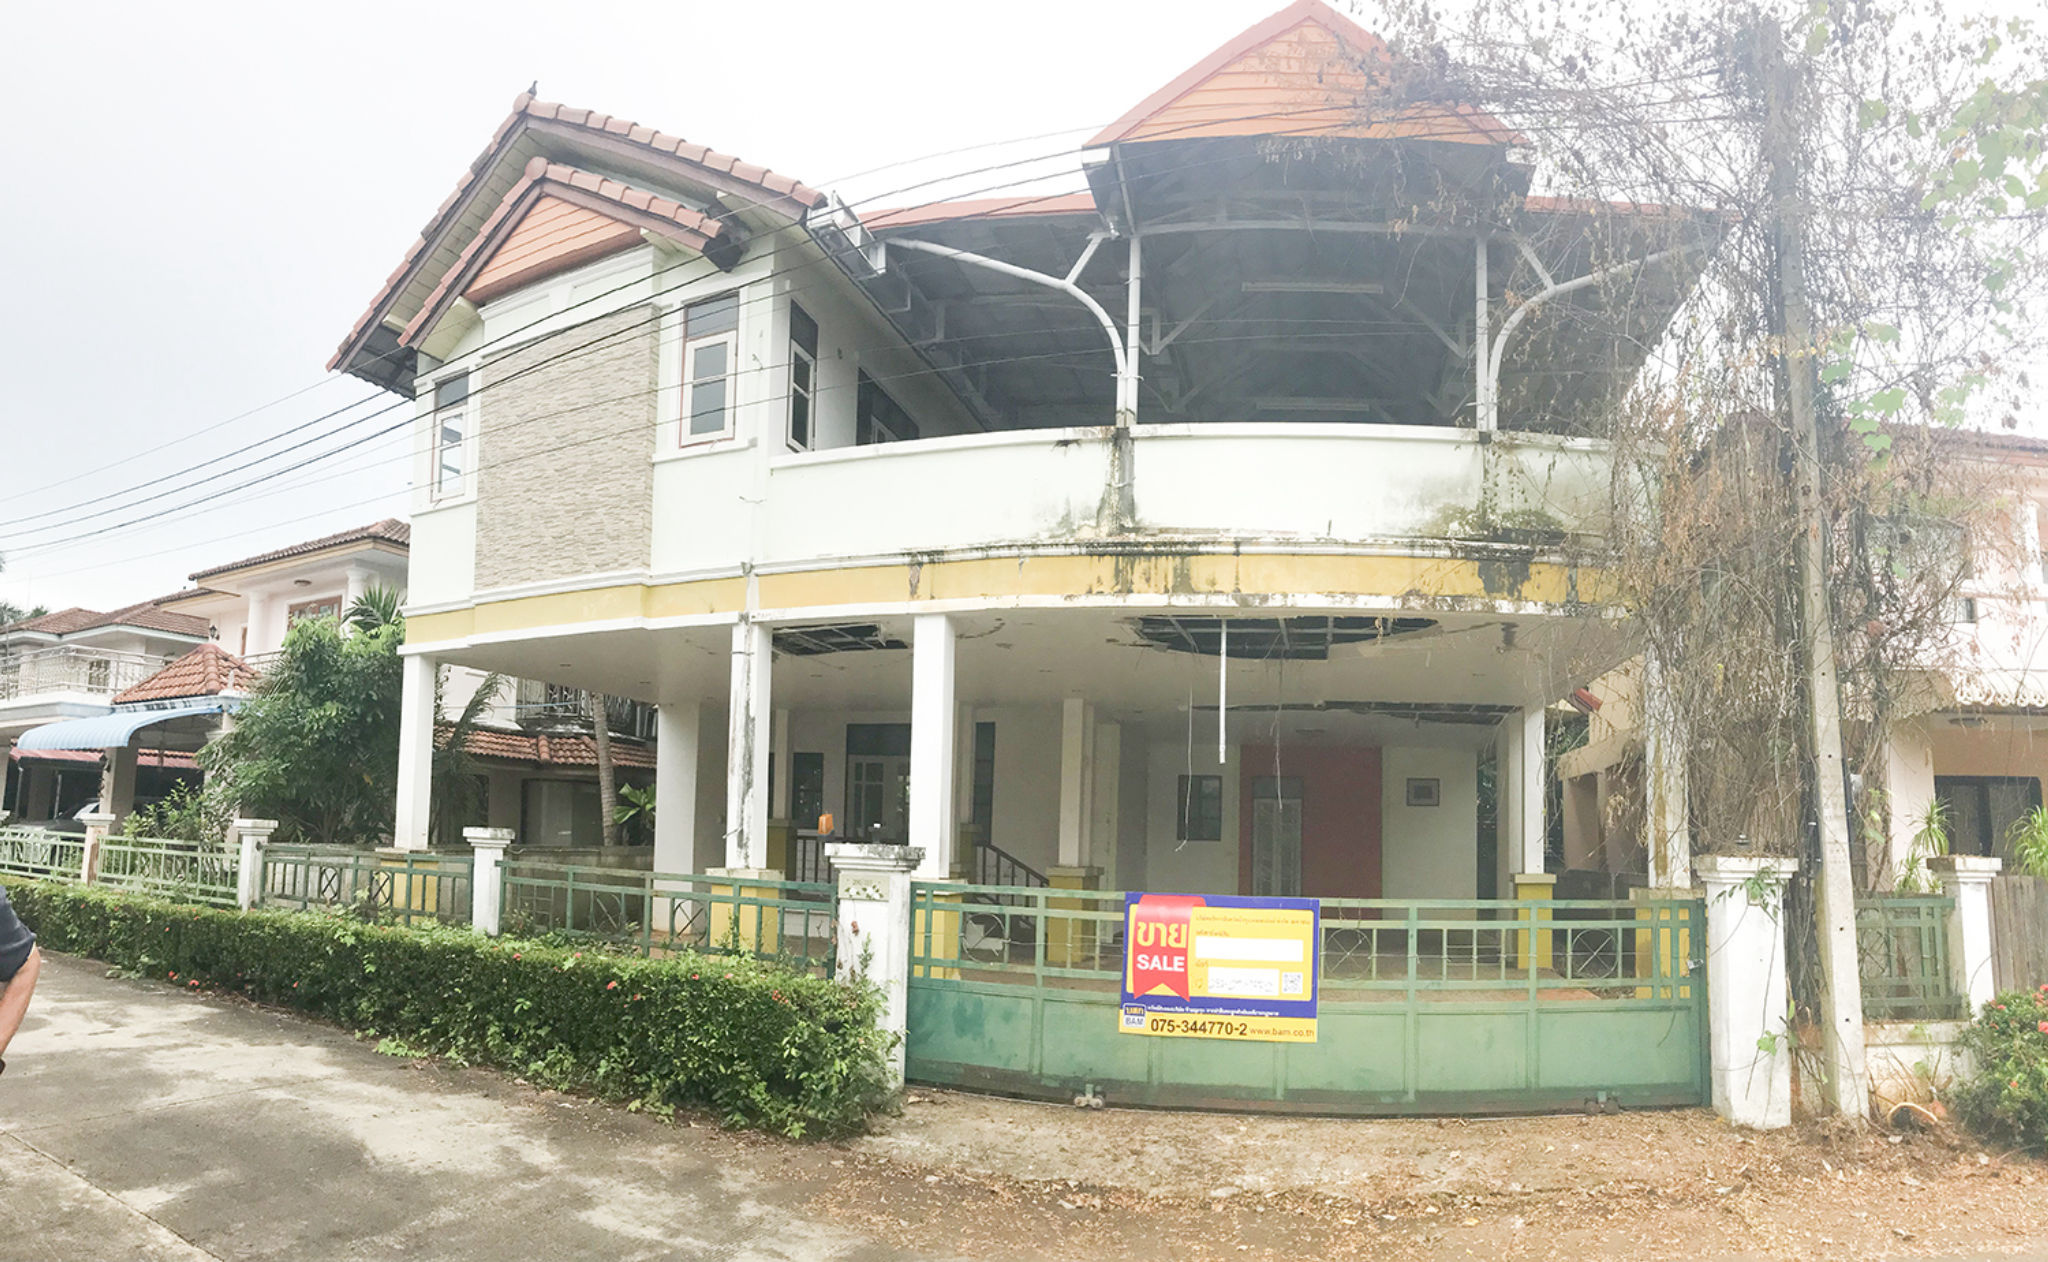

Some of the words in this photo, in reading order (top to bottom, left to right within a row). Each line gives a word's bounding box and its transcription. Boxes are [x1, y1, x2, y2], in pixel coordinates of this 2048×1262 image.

[1137, 921, 1187, 948] ขาย
[1136, 954, 1185, 972] SALE
[1125, 1017, 1144, 1026] BAM
[1150, 1018, 1248, 1036] 075-344770-2
[1249, 1027, 1315, 1038] www.bam.co.th
